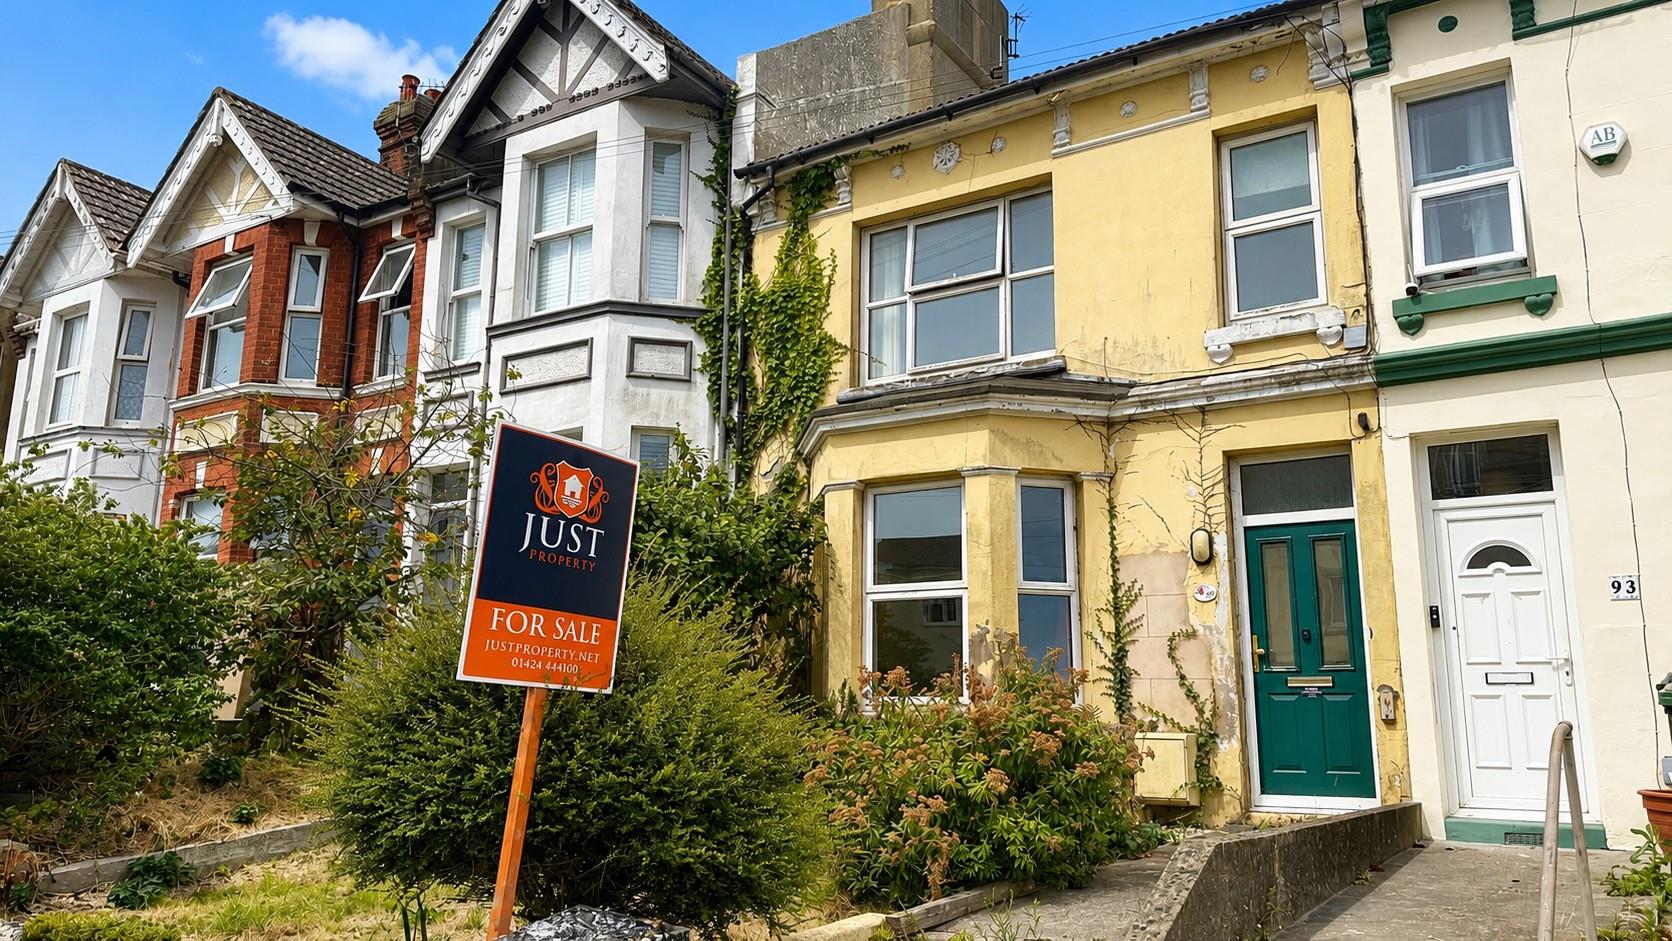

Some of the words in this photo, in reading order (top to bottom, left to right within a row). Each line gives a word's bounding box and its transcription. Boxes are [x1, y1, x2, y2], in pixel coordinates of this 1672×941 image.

[1591, 126, 1616, 144] AB
[518, 512, 605, 558] JUST
[529, 548, 596, 572] PROPERTY
[1611, 580, 1636, 594] 93
[489, 607, 546, 638] FOR
[552, 616, 602, 645] SALE
[484, 639, 601, 664] JUSTPROPERTY.NET
[511, 657, 542, 671] 01424
[545, 661, 579, 674] 444100
